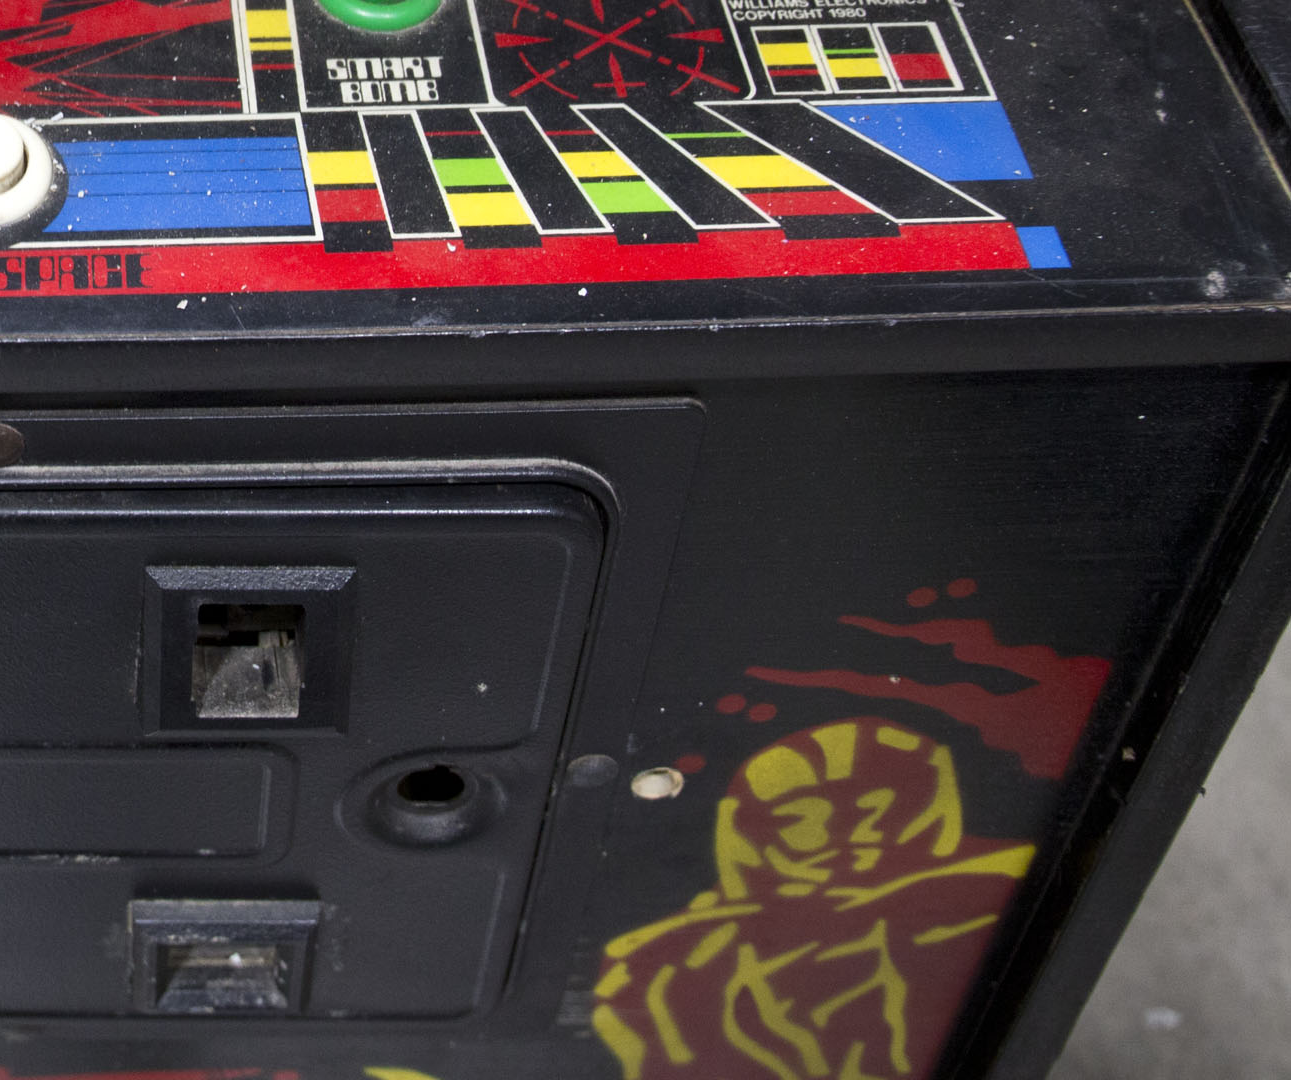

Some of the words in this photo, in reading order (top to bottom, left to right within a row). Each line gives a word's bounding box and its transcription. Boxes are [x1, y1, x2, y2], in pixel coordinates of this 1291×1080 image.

[733, 8, 824, 21] COPYRIGHT
[829, 7, 866, 18] 1980
[326, 56, 444, 80] SMART
[340, 79, 440, 103] BOMB
